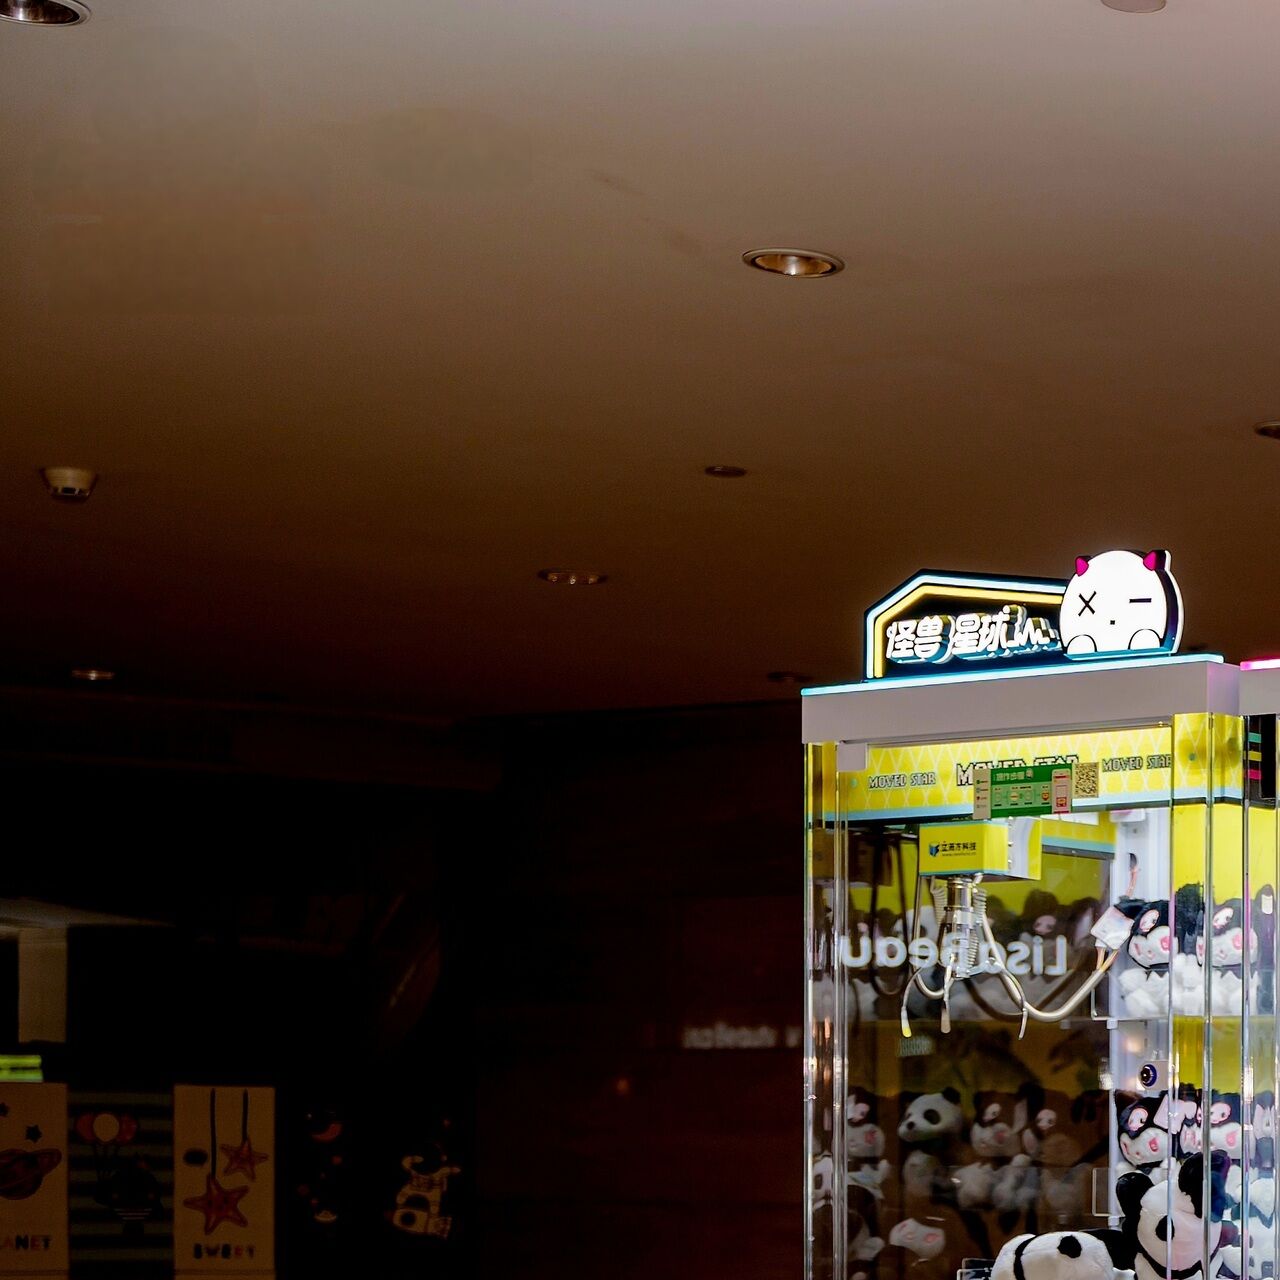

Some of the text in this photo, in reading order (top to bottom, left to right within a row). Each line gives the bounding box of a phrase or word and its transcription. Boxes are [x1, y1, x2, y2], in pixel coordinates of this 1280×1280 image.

[1102, 754, 1171, 772] MOVED STAR
[868, 772, 936, 789] MOVED STAR
